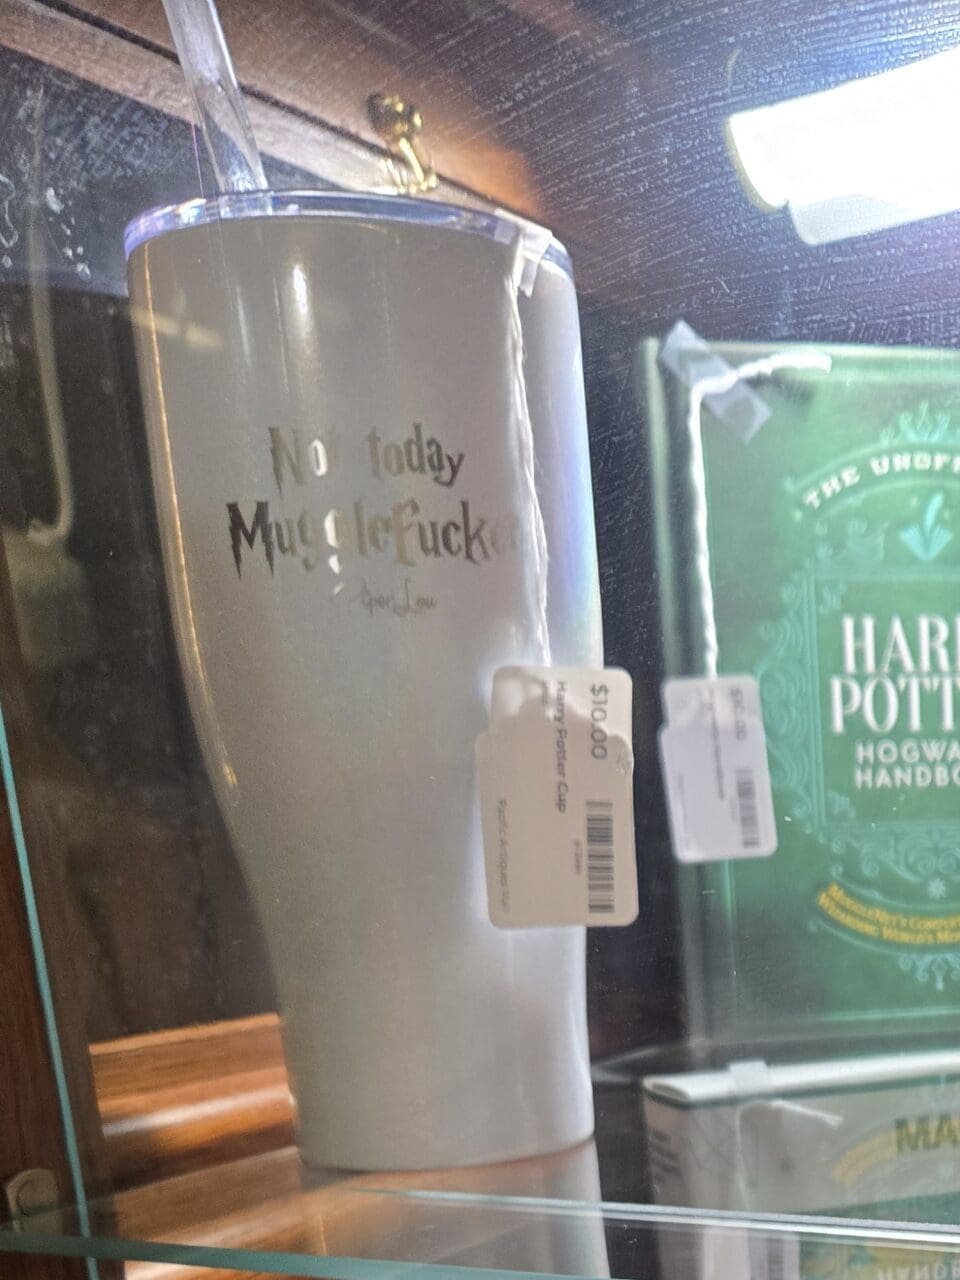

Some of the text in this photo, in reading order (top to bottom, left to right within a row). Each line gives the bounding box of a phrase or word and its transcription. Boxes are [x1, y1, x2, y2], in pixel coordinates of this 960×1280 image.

[365, 423, 465, 488] today
[803, 465, 842, 511] THE
[553, 680, 569, 814] Harry Potter Cup
[590, 682, 609, 760] $10.00
